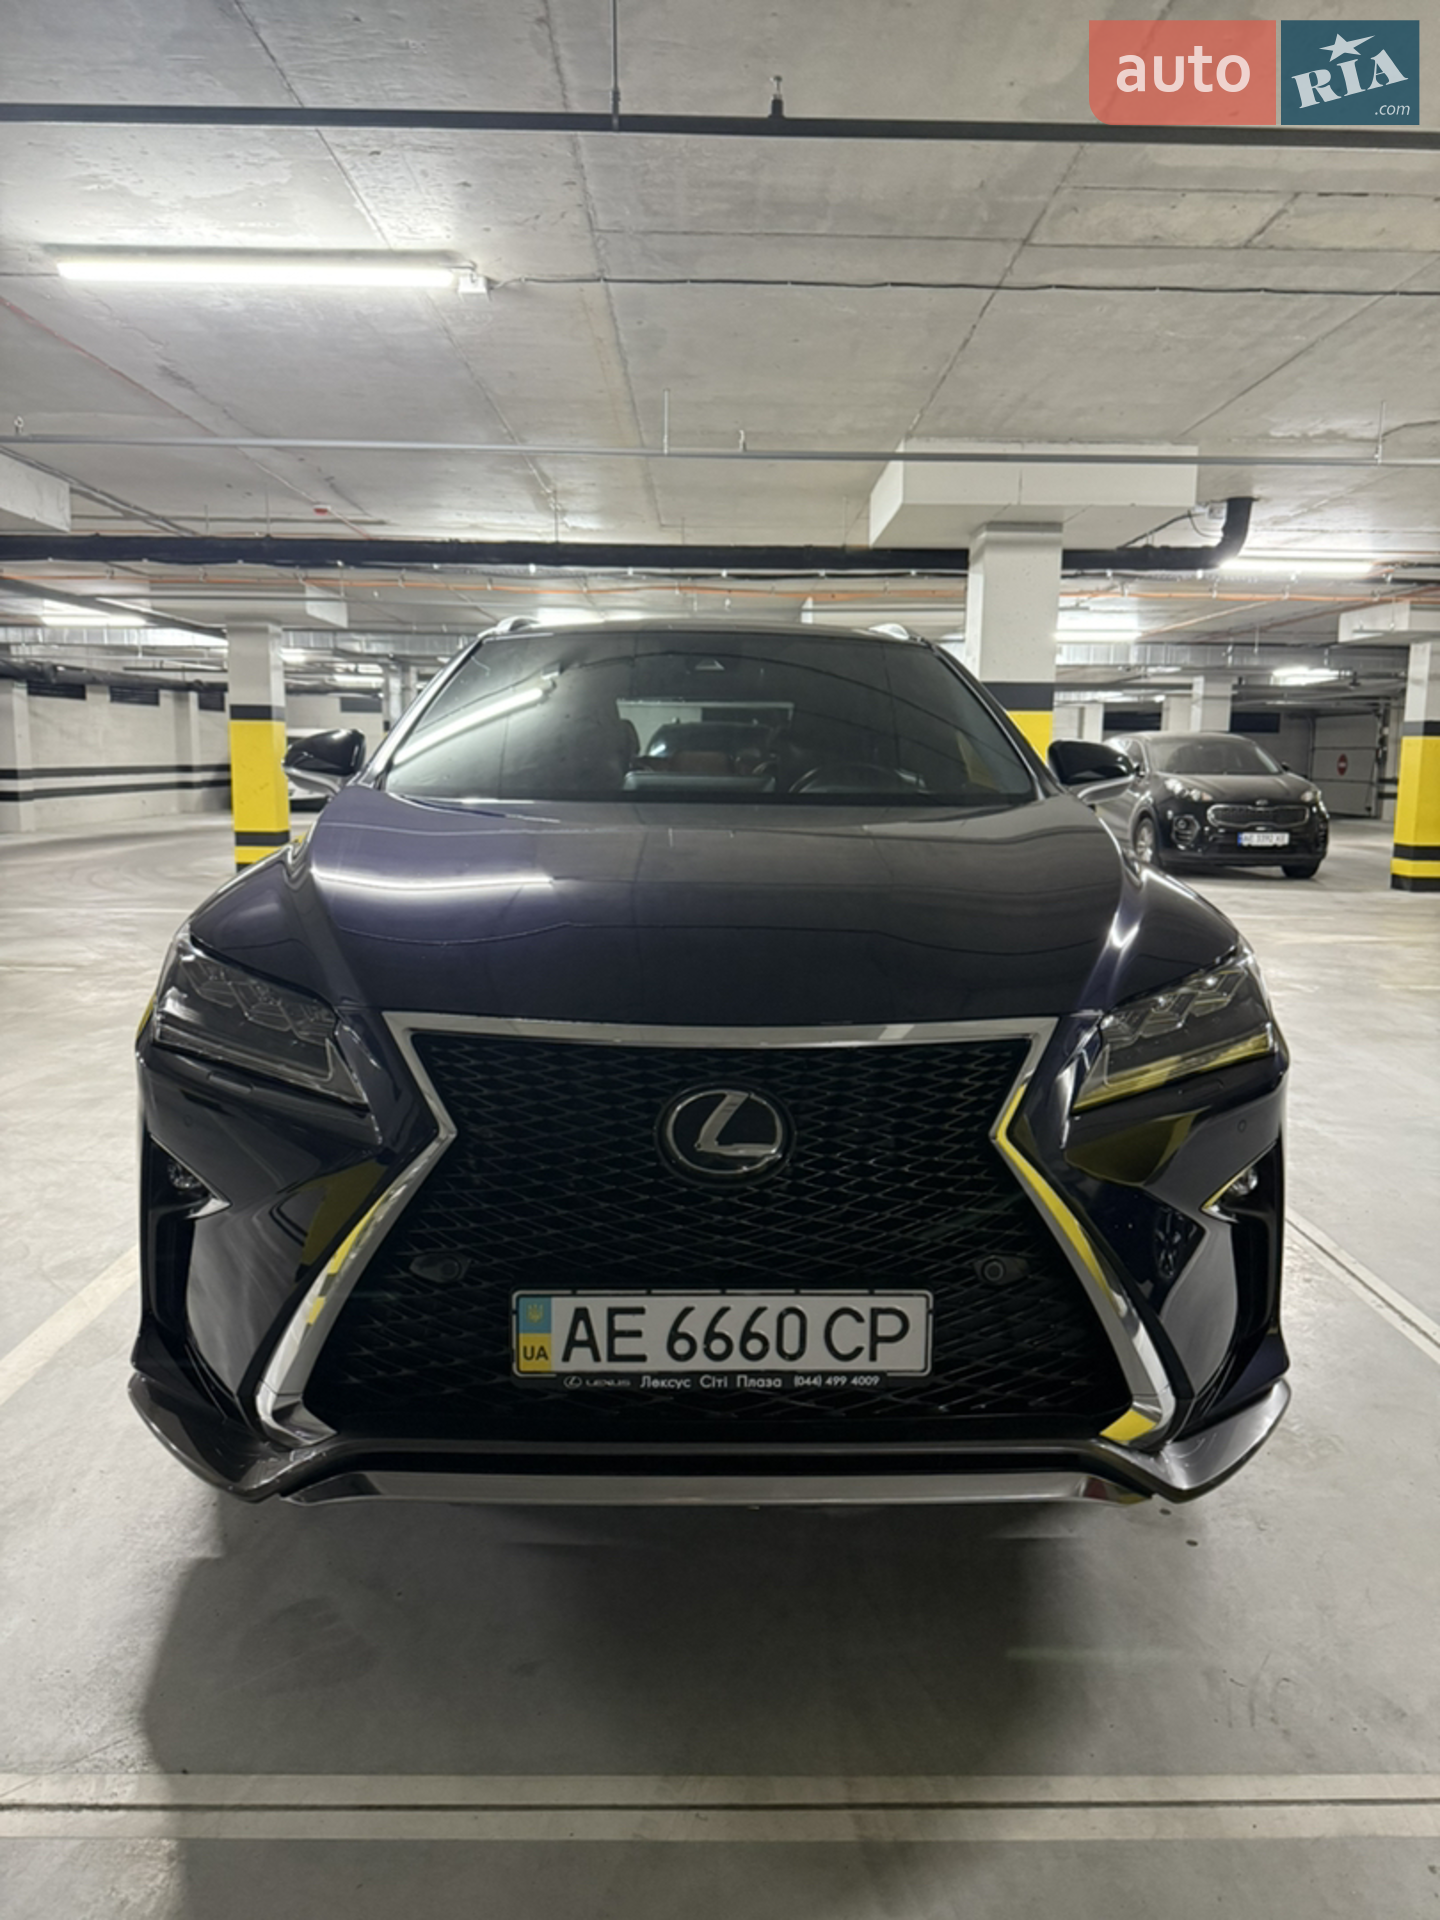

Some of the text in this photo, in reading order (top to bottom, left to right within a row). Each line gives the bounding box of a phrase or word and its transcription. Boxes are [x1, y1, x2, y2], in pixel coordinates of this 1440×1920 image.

[561, 1305, 910, 1363] AE 6660 CP
[523, 1345, 549, 1361] UA
[639, 1374, 881, 1389] Лексус Сіті Плаза (044) 499 4009
